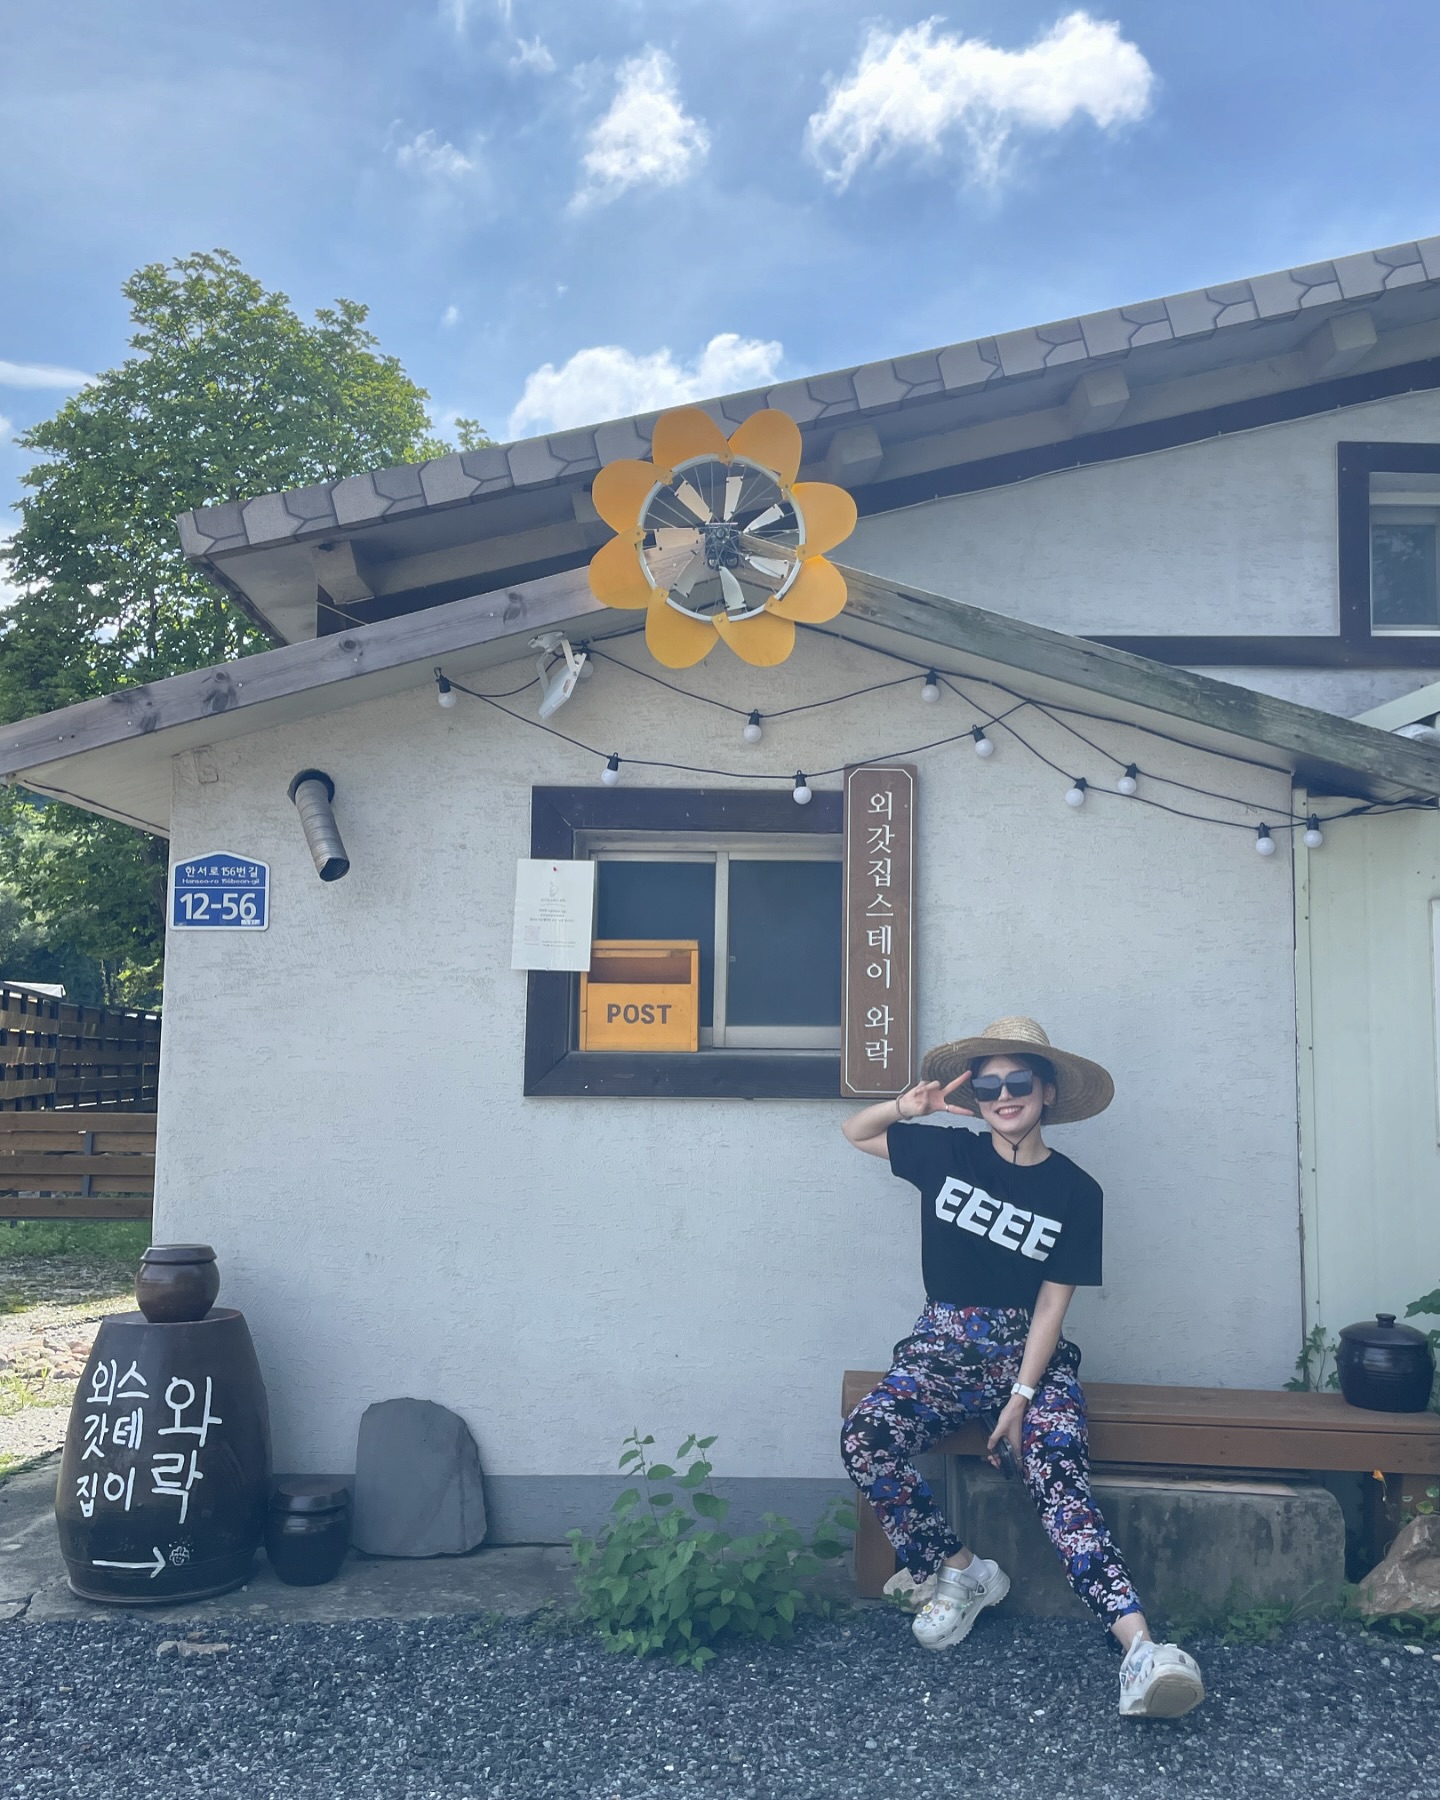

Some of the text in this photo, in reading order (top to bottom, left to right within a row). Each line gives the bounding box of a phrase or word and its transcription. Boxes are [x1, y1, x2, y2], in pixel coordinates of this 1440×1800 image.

[179, 892, 257, 920] 12-56
[606, 1003, 672, 1025] POST
[935, 1175, 1063, 1262] EEEE
